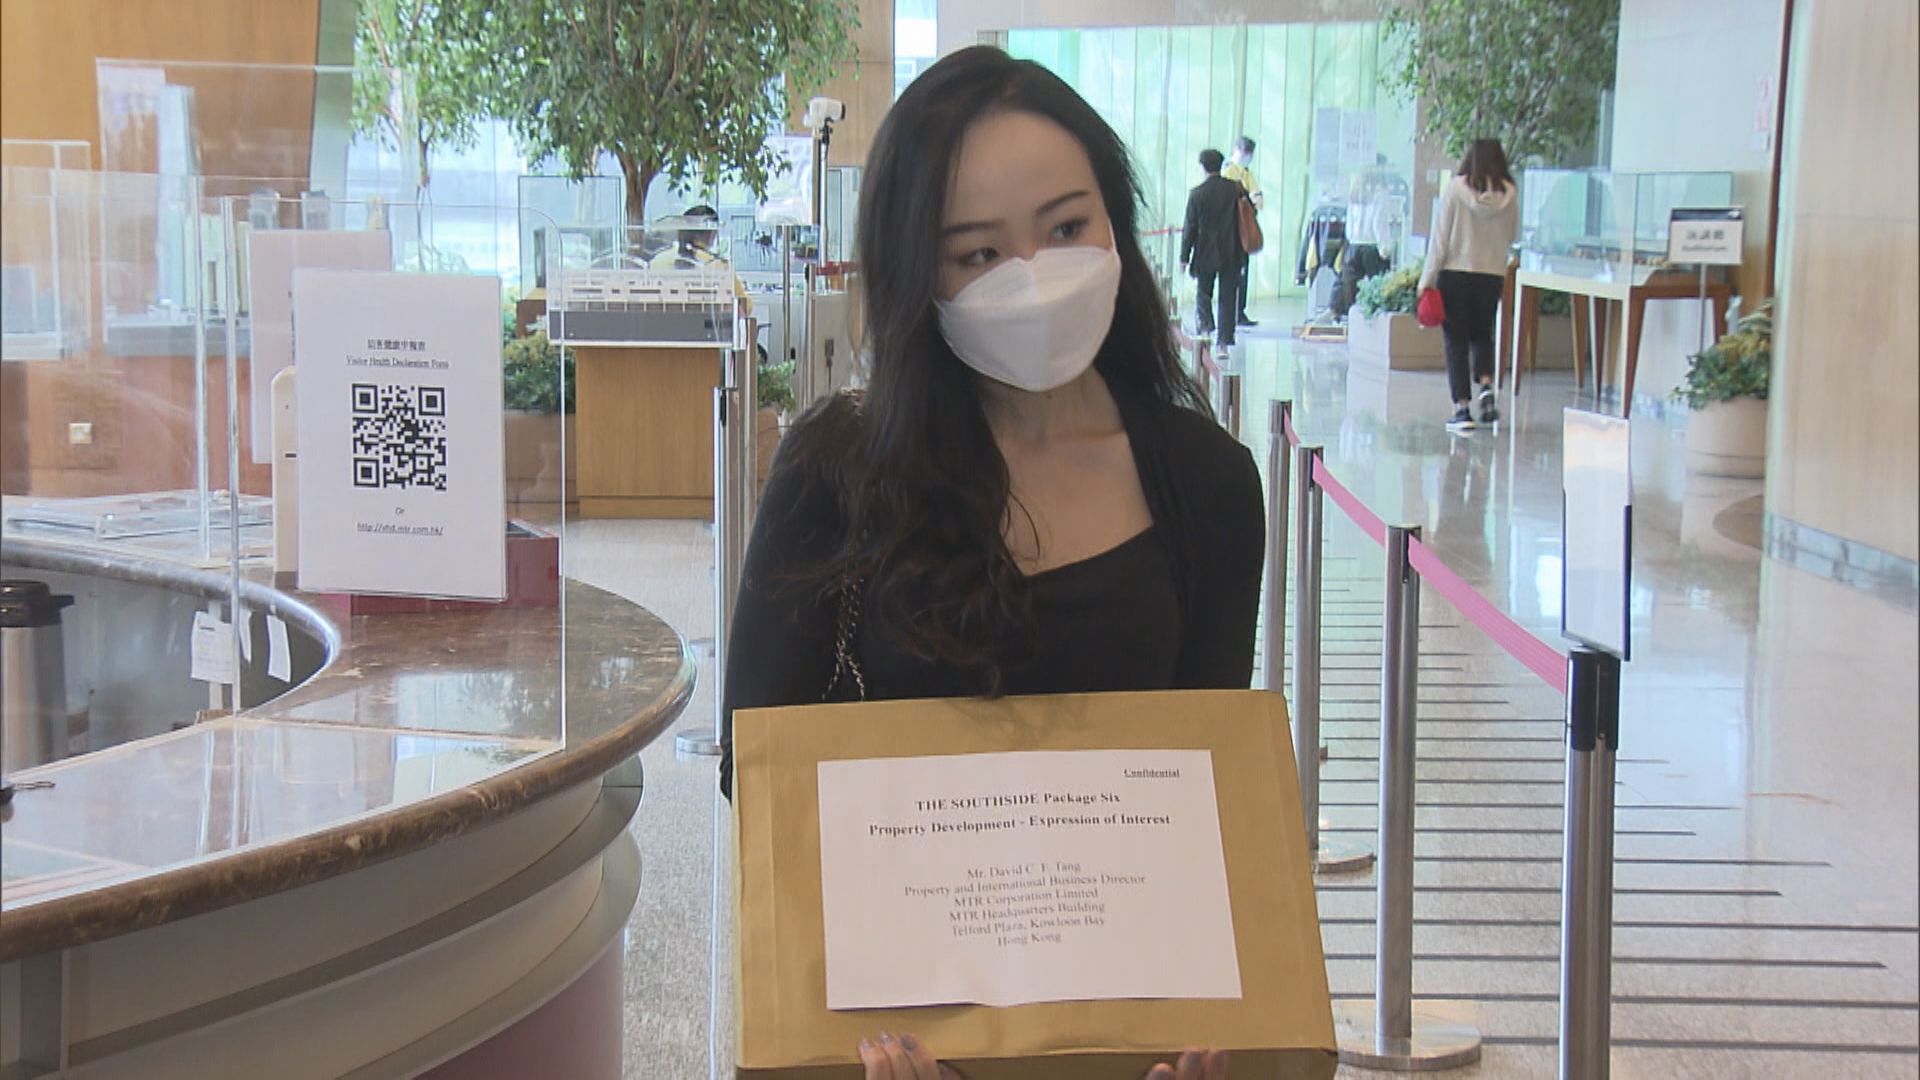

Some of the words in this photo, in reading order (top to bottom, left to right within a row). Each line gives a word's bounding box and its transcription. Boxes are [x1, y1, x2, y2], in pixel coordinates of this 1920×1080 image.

[369, 356, 391, 368] Health
[392, 357, 430, 370] Declaration
[431, 359, 449, 370] Form
[1123, 768, 1181, 778] Confidential
[916, 799, 947, 812] THE
[951, 794, 1039, 810] SOUTHSIDE
[1043, 792, 1097, 805] Package
[1100, 792, 1121, 803] Six
[869, 823, 927, 837] Property
[931, 819, 1016, 835] Development
[1029, 814, 1100, 829] Expression
[1103, 813, 1116, 824] of
[1120, 813, 1170, 825] Interest
[967, 867, 987, 879] Mr.
[990, 864, 1023, 877] David
[1055, 861, 1082, 873] Tang
[904, 884, 950, 898] Property
[954, 882, 974, 894] and
[977, 877, 1046, 893] International
[1049, 873, 1097, 887] Business
[1101, 872, 1146, 885] Director
[953, 895, 983, 908] MTR
[987, 889, 1052, 906] Corporation
[1055, 887, 1099, 900] Limited
[949, 910, 978, 923] MTR
[982, 903, 1054, 920] Headquarters
[1058, 901, 1105, 914] Building
[952, 924, 991, 937] Telford
[994, 919, 1027, 933] Plaza,
[1030, 916, 1080, 929] Kowloon
[1084, 914, 1105, 927] Bay
[997, 934, 1028, 947] Hong
[1031, 931, 1062, 945] Kong
